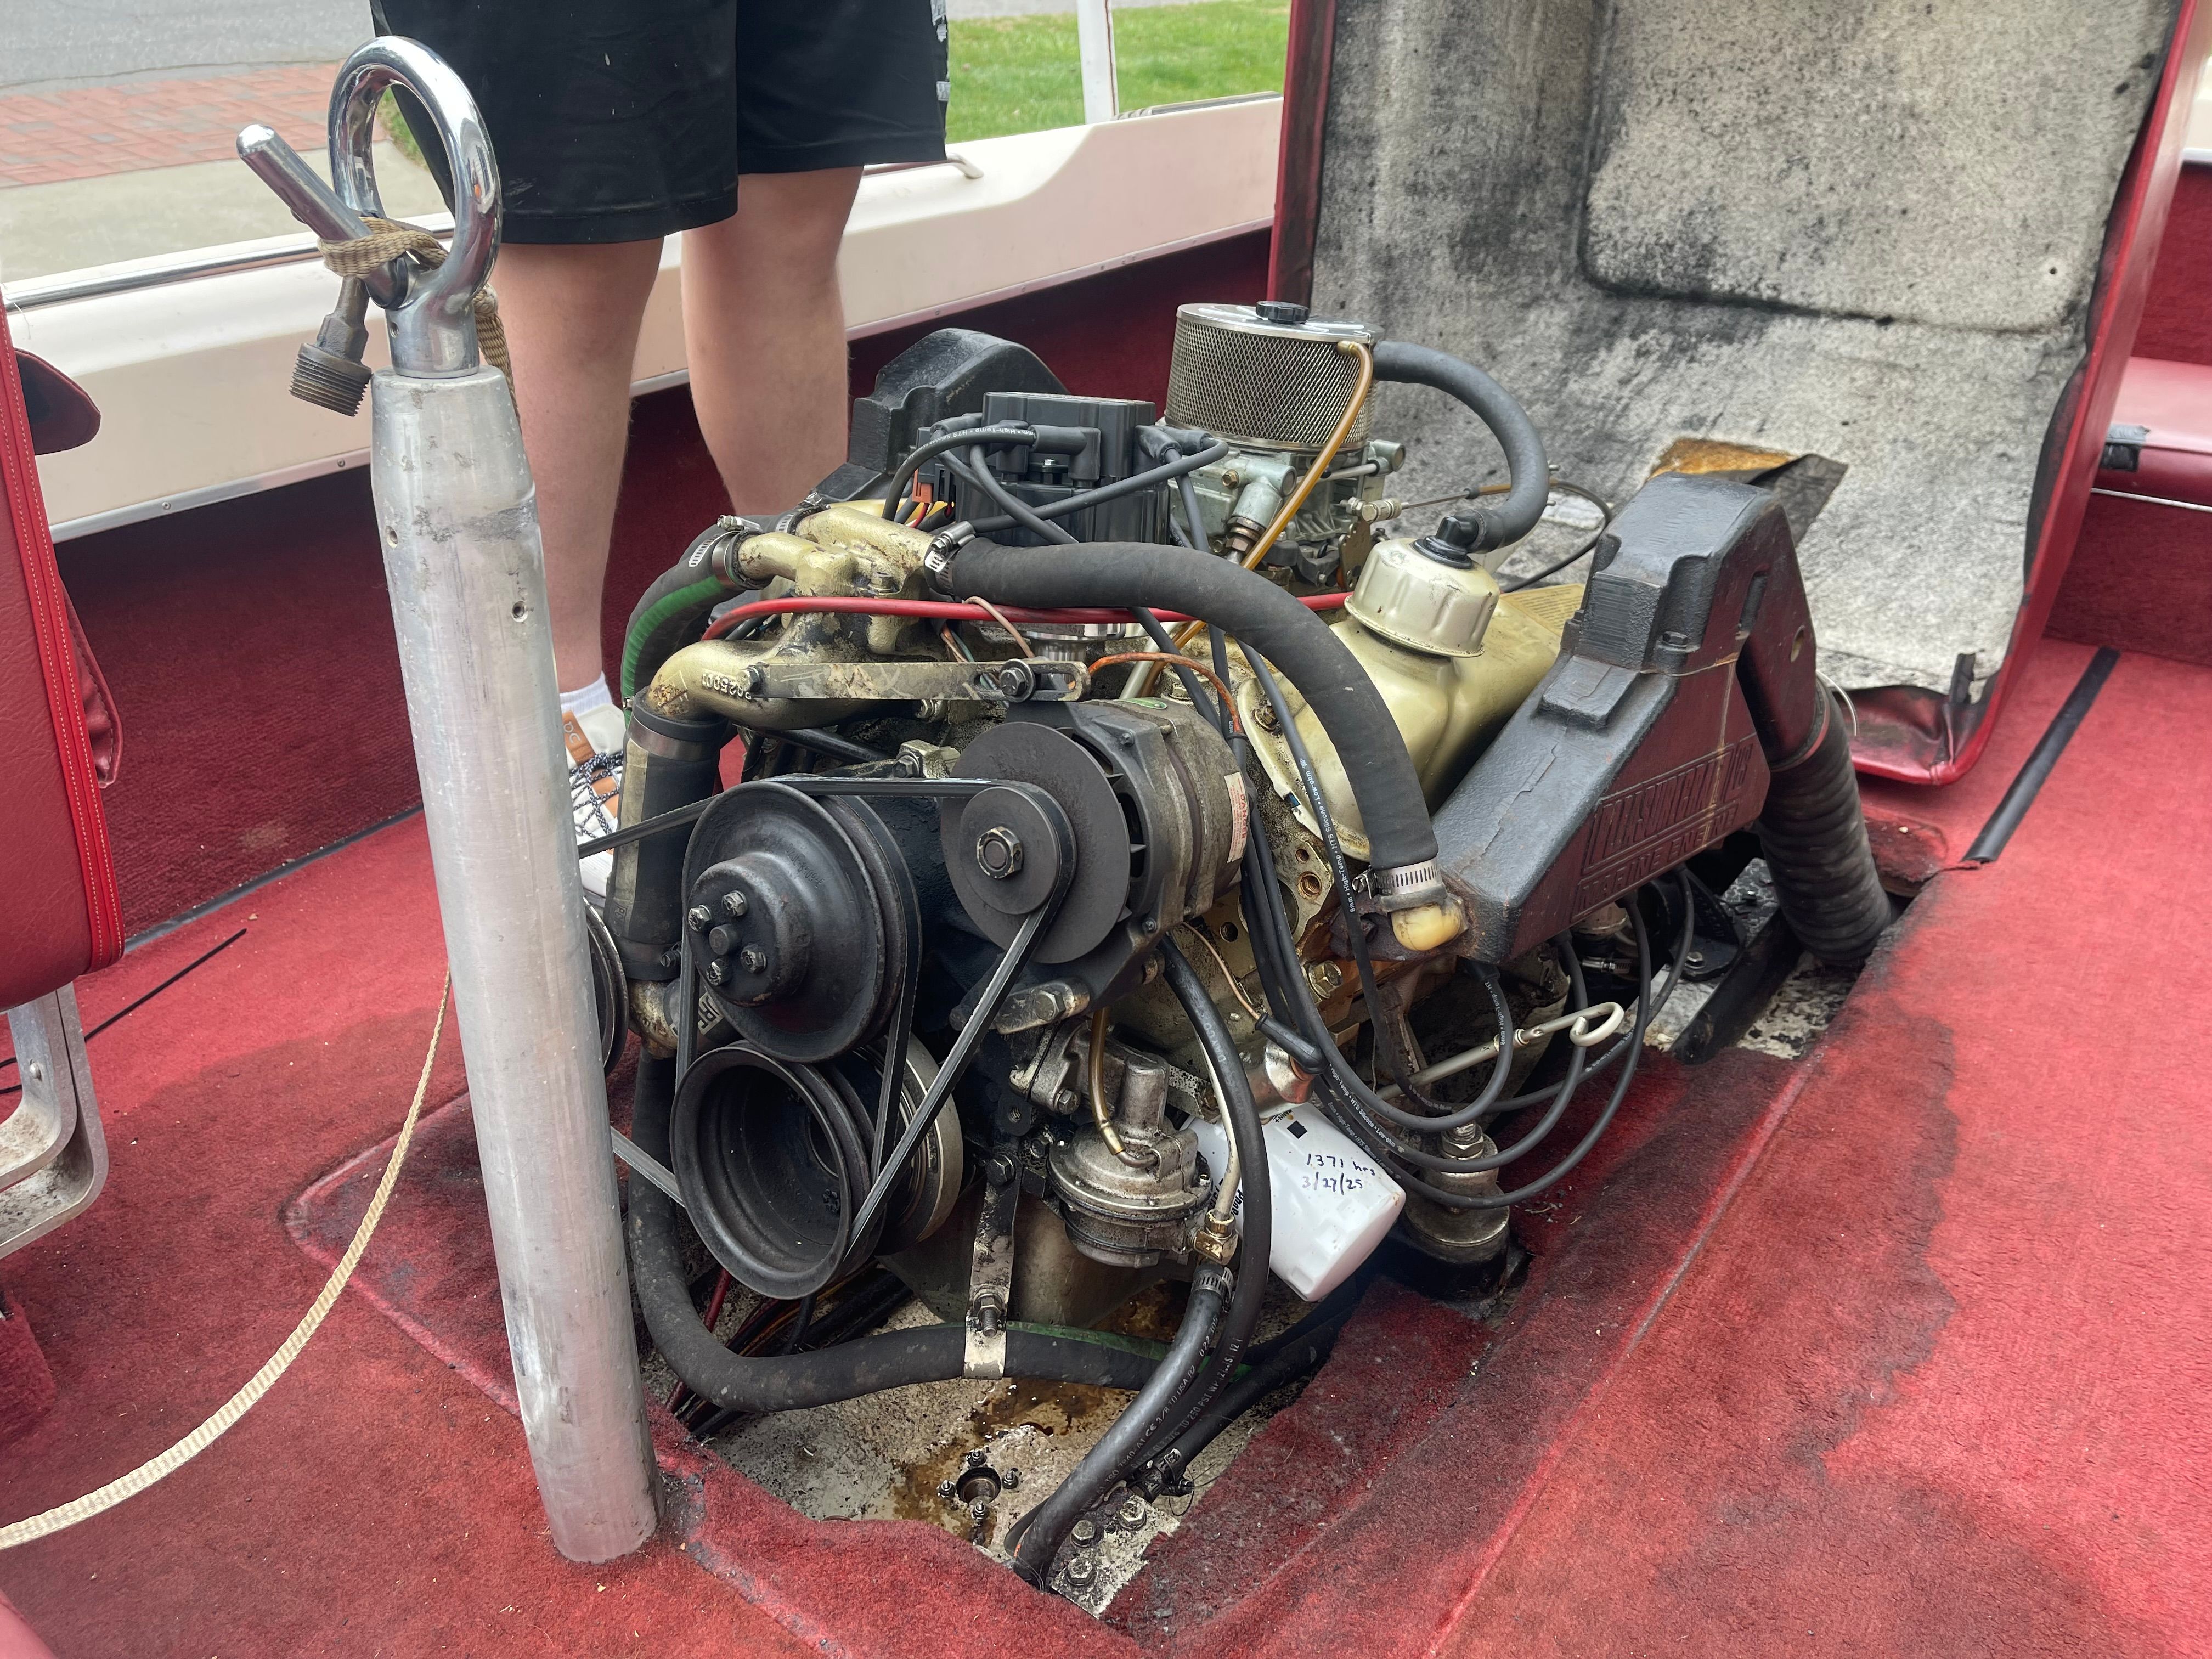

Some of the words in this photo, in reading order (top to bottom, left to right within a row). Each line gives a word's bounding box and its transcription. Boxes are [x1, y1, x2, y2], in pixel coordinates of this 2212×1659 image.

[1306, 770, 1321, 800] Low-ohm
[1319, 806, 1333, 832] Silicone
[1329, 833, 1338, 850] HTS
[1335, 854, 1350, 892] High-Temp
[1581, 847, 1663, 909] MARINE
[1492, 994, 1504, 1026] High-Temp
[1204, 1022, 1226, 1062] DAYCO
[1350, 1097, 1359, 1110] HTS
[1359, 1108, 1374, 1127] Silicone
[1376, 1128, 1396, 1147] Low-ohm
[1307, 1153, 1344, 1168] 1371
[1353, 1161, 1375, 1176] hrs
[1302, 1171, 1363, 1195] 3/27/25
[1156, 1406, 1170, 1426] 3/8
[1176, 1378, 1189, 1395] USA
[1187, 1407, 1200, 1420] 250
[1198, 1393, 1212, 1407] PSI
